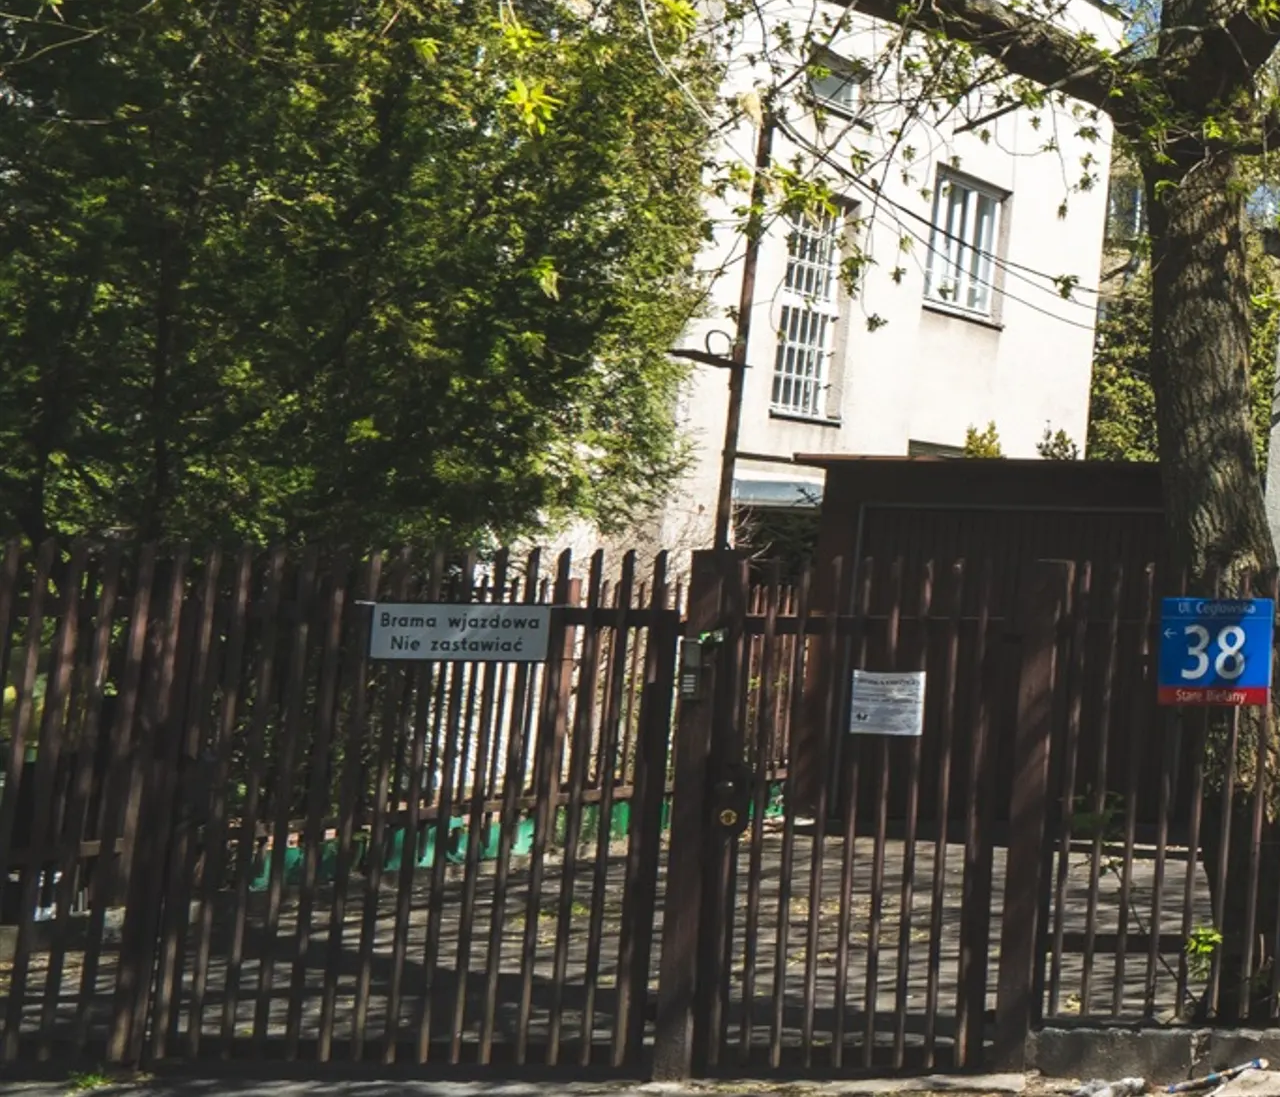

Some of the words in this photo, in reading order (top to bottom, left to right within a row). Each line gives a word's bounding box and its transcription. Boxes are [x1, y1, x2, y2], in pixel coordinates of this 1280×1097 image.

[380, 612, 437, 628] Brama
[448, 613, 540, 632] wjazdowa
[390, 635, 421, 651] Nie
[430, 636, 524, 653] zastawiać
[1181, 624, 1246, 680] 38
